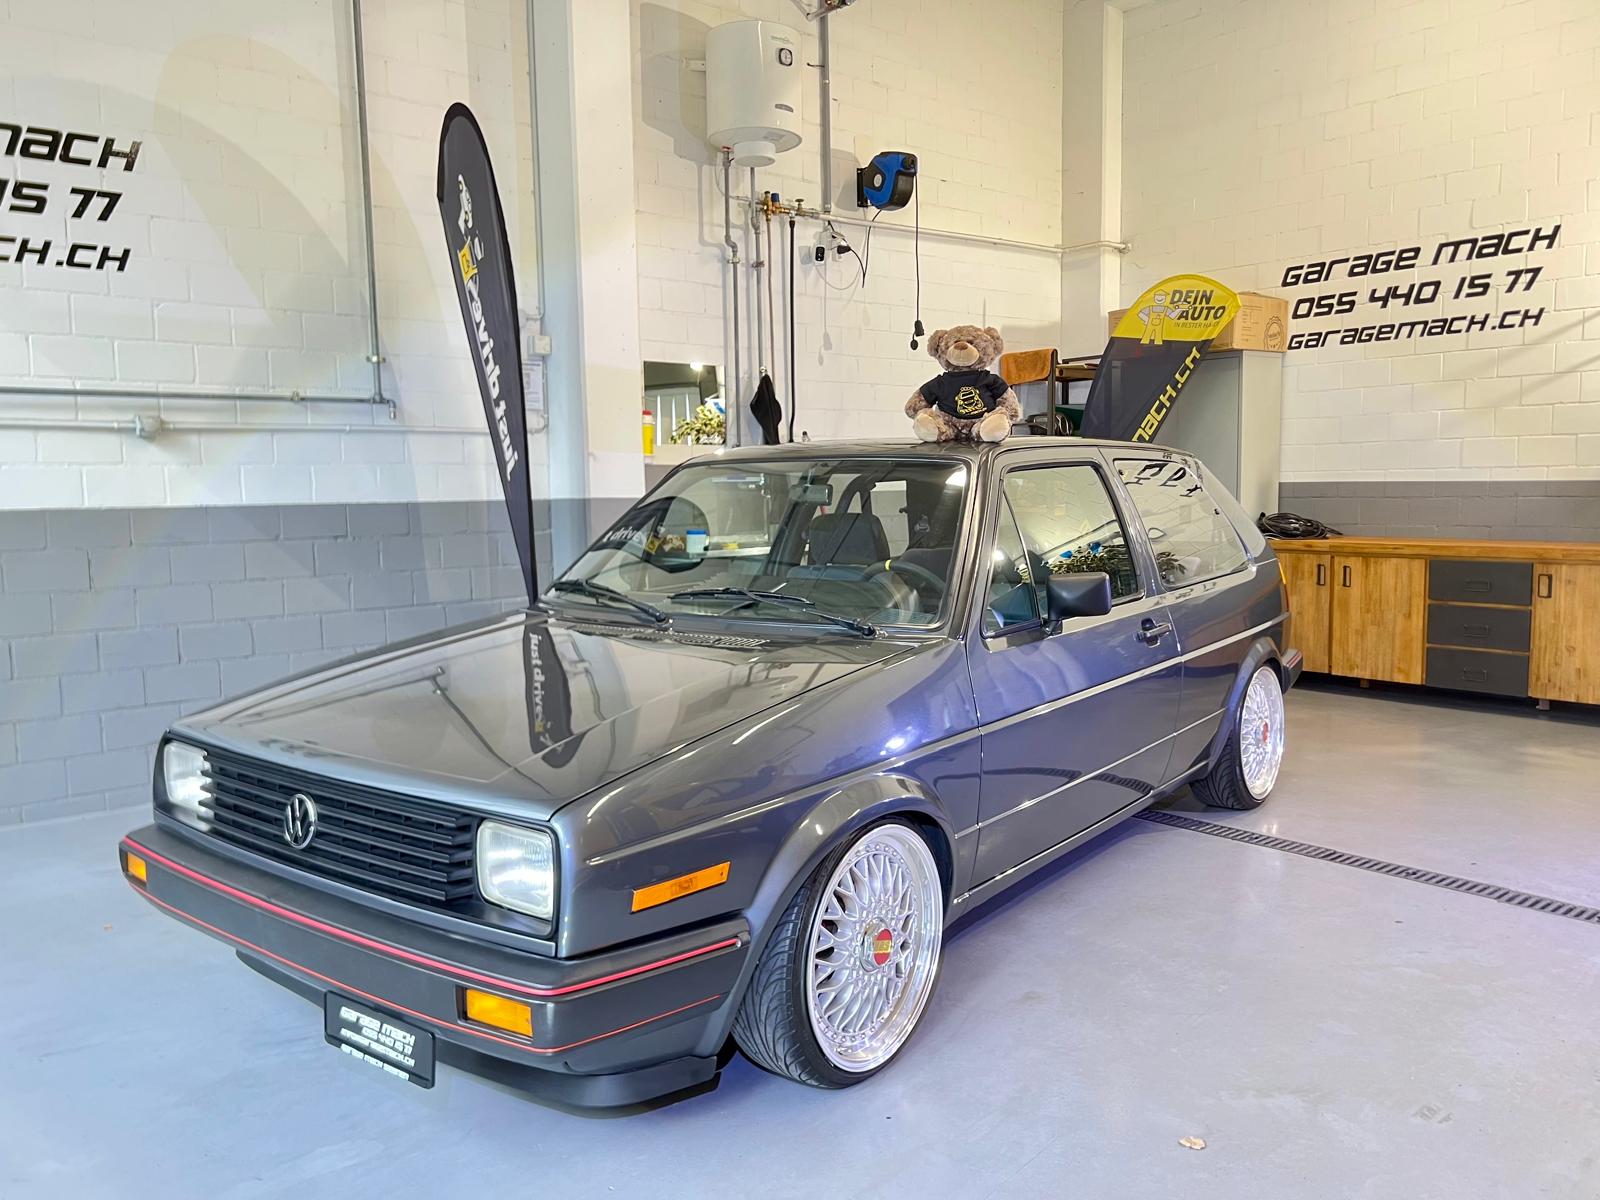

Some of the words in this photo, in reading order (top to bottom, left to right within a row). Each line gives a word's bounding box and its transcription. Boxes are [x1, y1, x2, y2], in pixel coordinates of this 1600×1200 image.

[69, 187, 123, 222] 77
[1170, 289, 1214, 305] DEIN
[1291, 290, 1358, 320] 055
[1368, 280, 1442, 309] 440
[1453, 273, 1493, 300] 15
[1505, 266, 1544, 294] 77
[1177, 305, 1226, 321] AUTO
